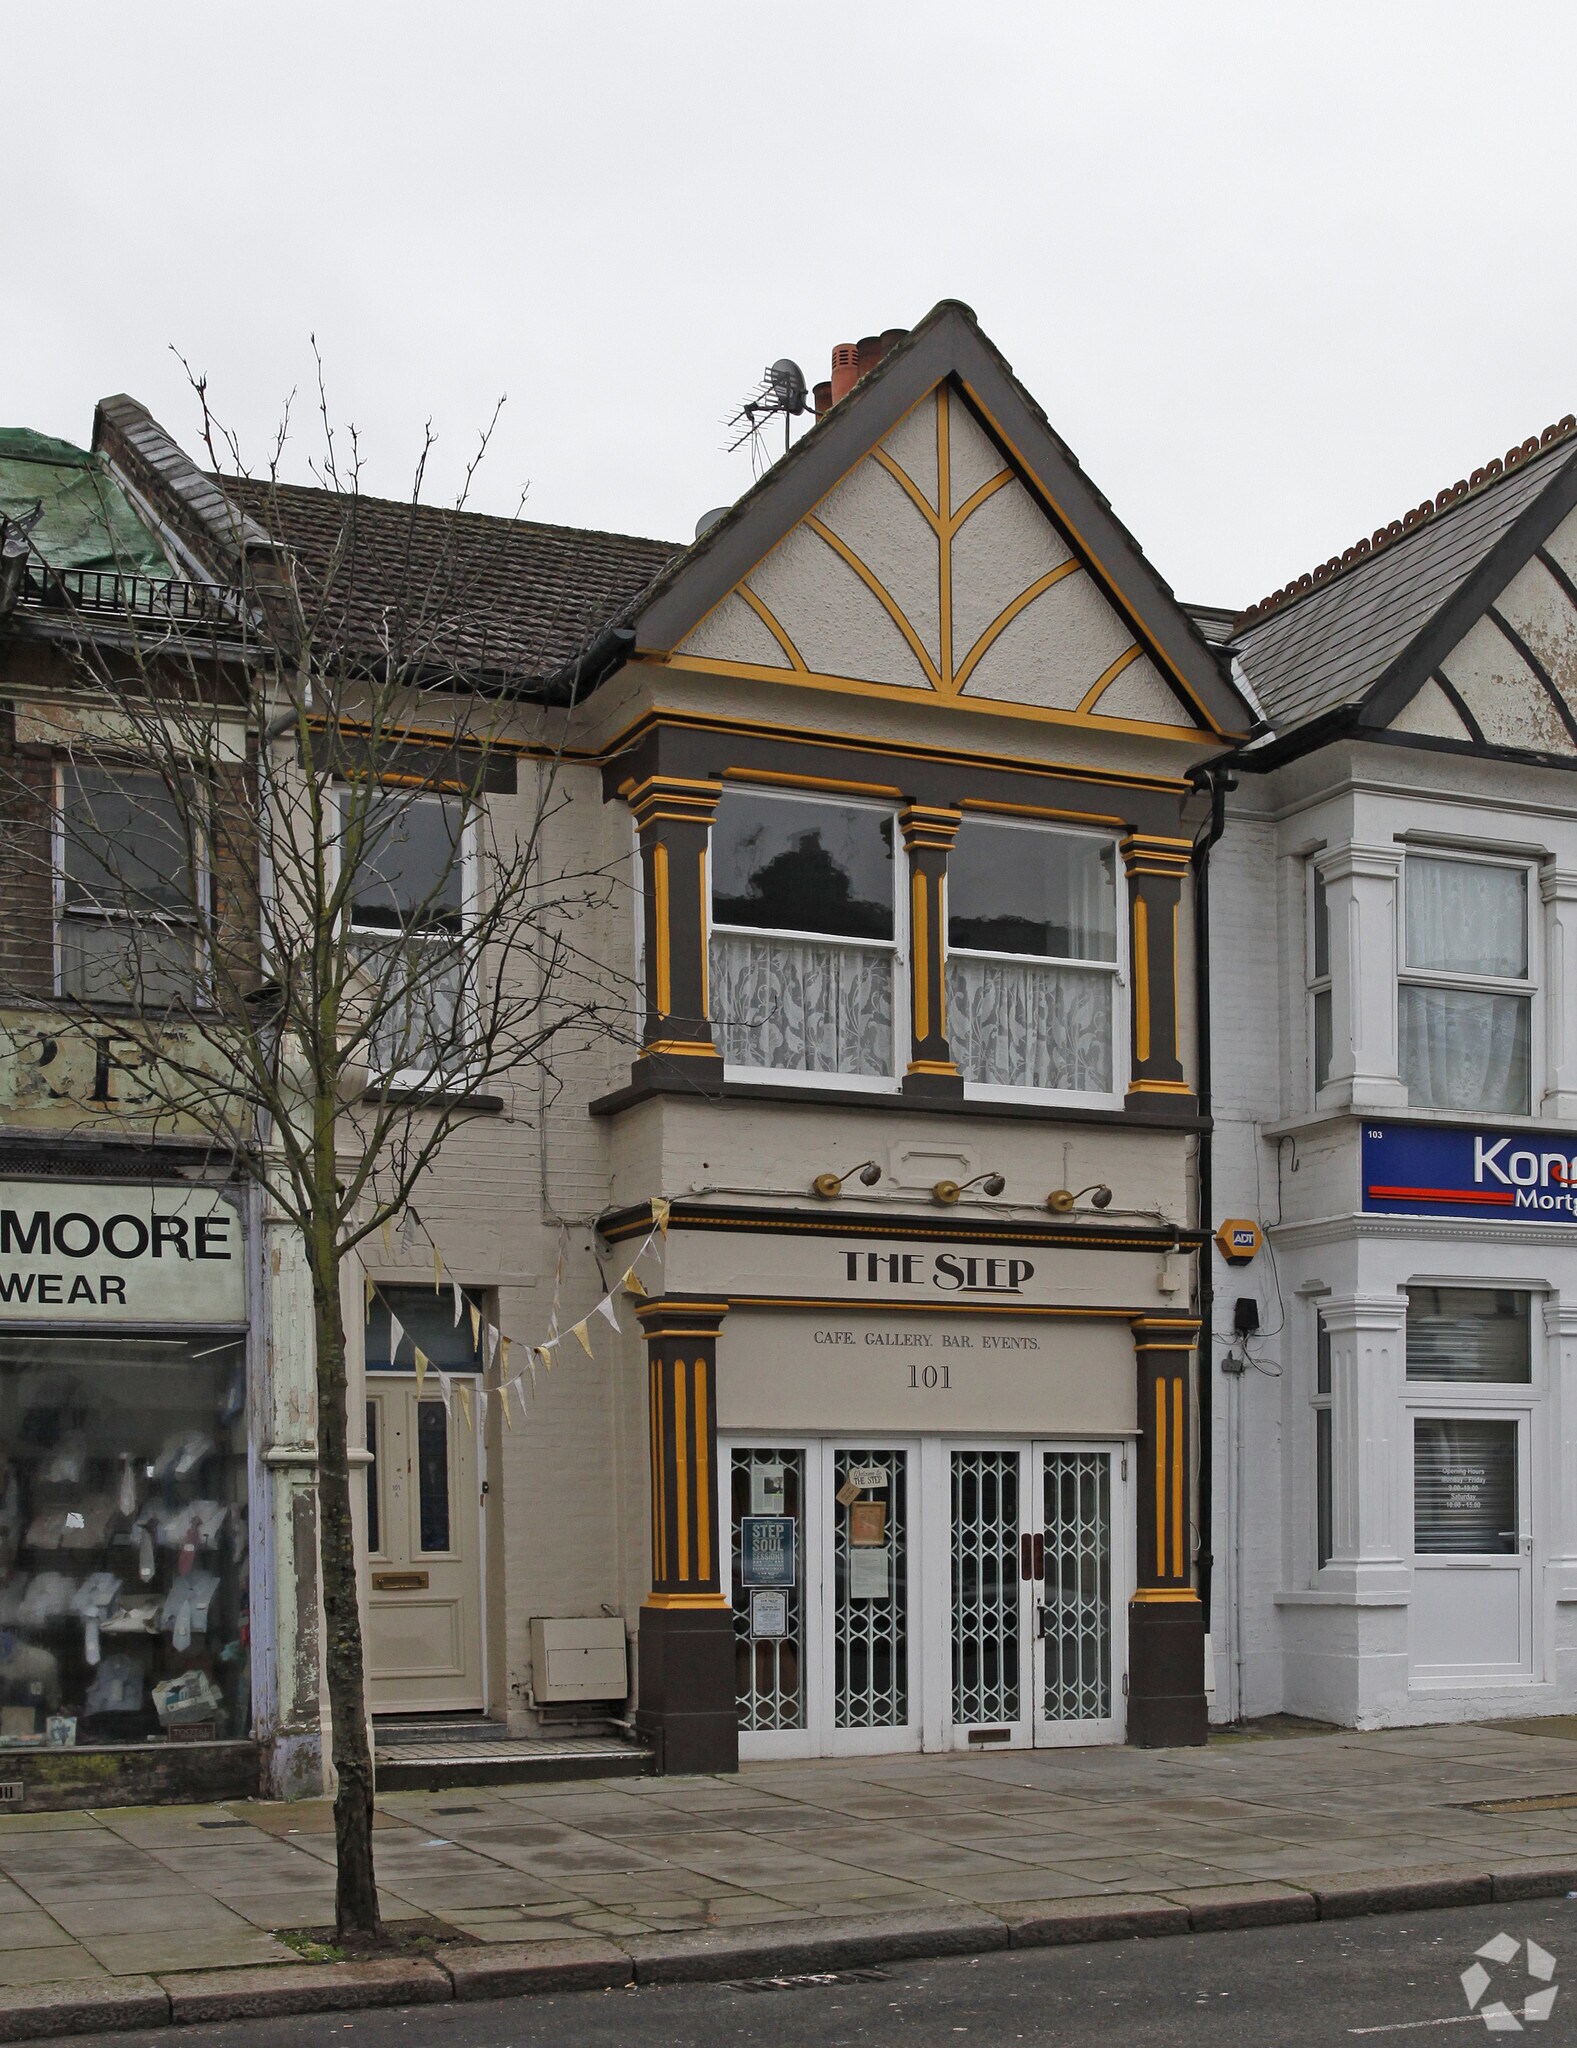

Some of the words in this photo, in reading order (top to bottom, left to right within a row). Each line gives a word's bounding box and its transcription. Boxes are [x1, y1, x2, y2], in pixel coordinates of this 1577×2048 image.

[1368, 1130, 1382, 1139] 103
[1474, 1136, 1577, 1188] Kon
[0, 1209, 232, 1260] MOORE
[1234, 1233, 1254, 1244] ADT
[838, 1251, 925, 1284] THE
[932, 1253, 1035, 1291] STEP
[0, 1273, 127, 1304] WEAR
[813, 1330, 856, 1345] CAFE.
[865, 1332, 933, 1348] GALLERY.
[942, 1334, 974, 1348] BAR.
[982, 1336, 1040, 1350] EVENTS.
[907, 1364, 952, 1388] 101
[1442, 1467, 1467, 1475] Opening
[854, 1477, 865, 1485] THE
[868, 1475, 882, 1484] STEP
[752, 1524, 784, 1538] STEP
[752, 1539, 784, 1552] SOUL
